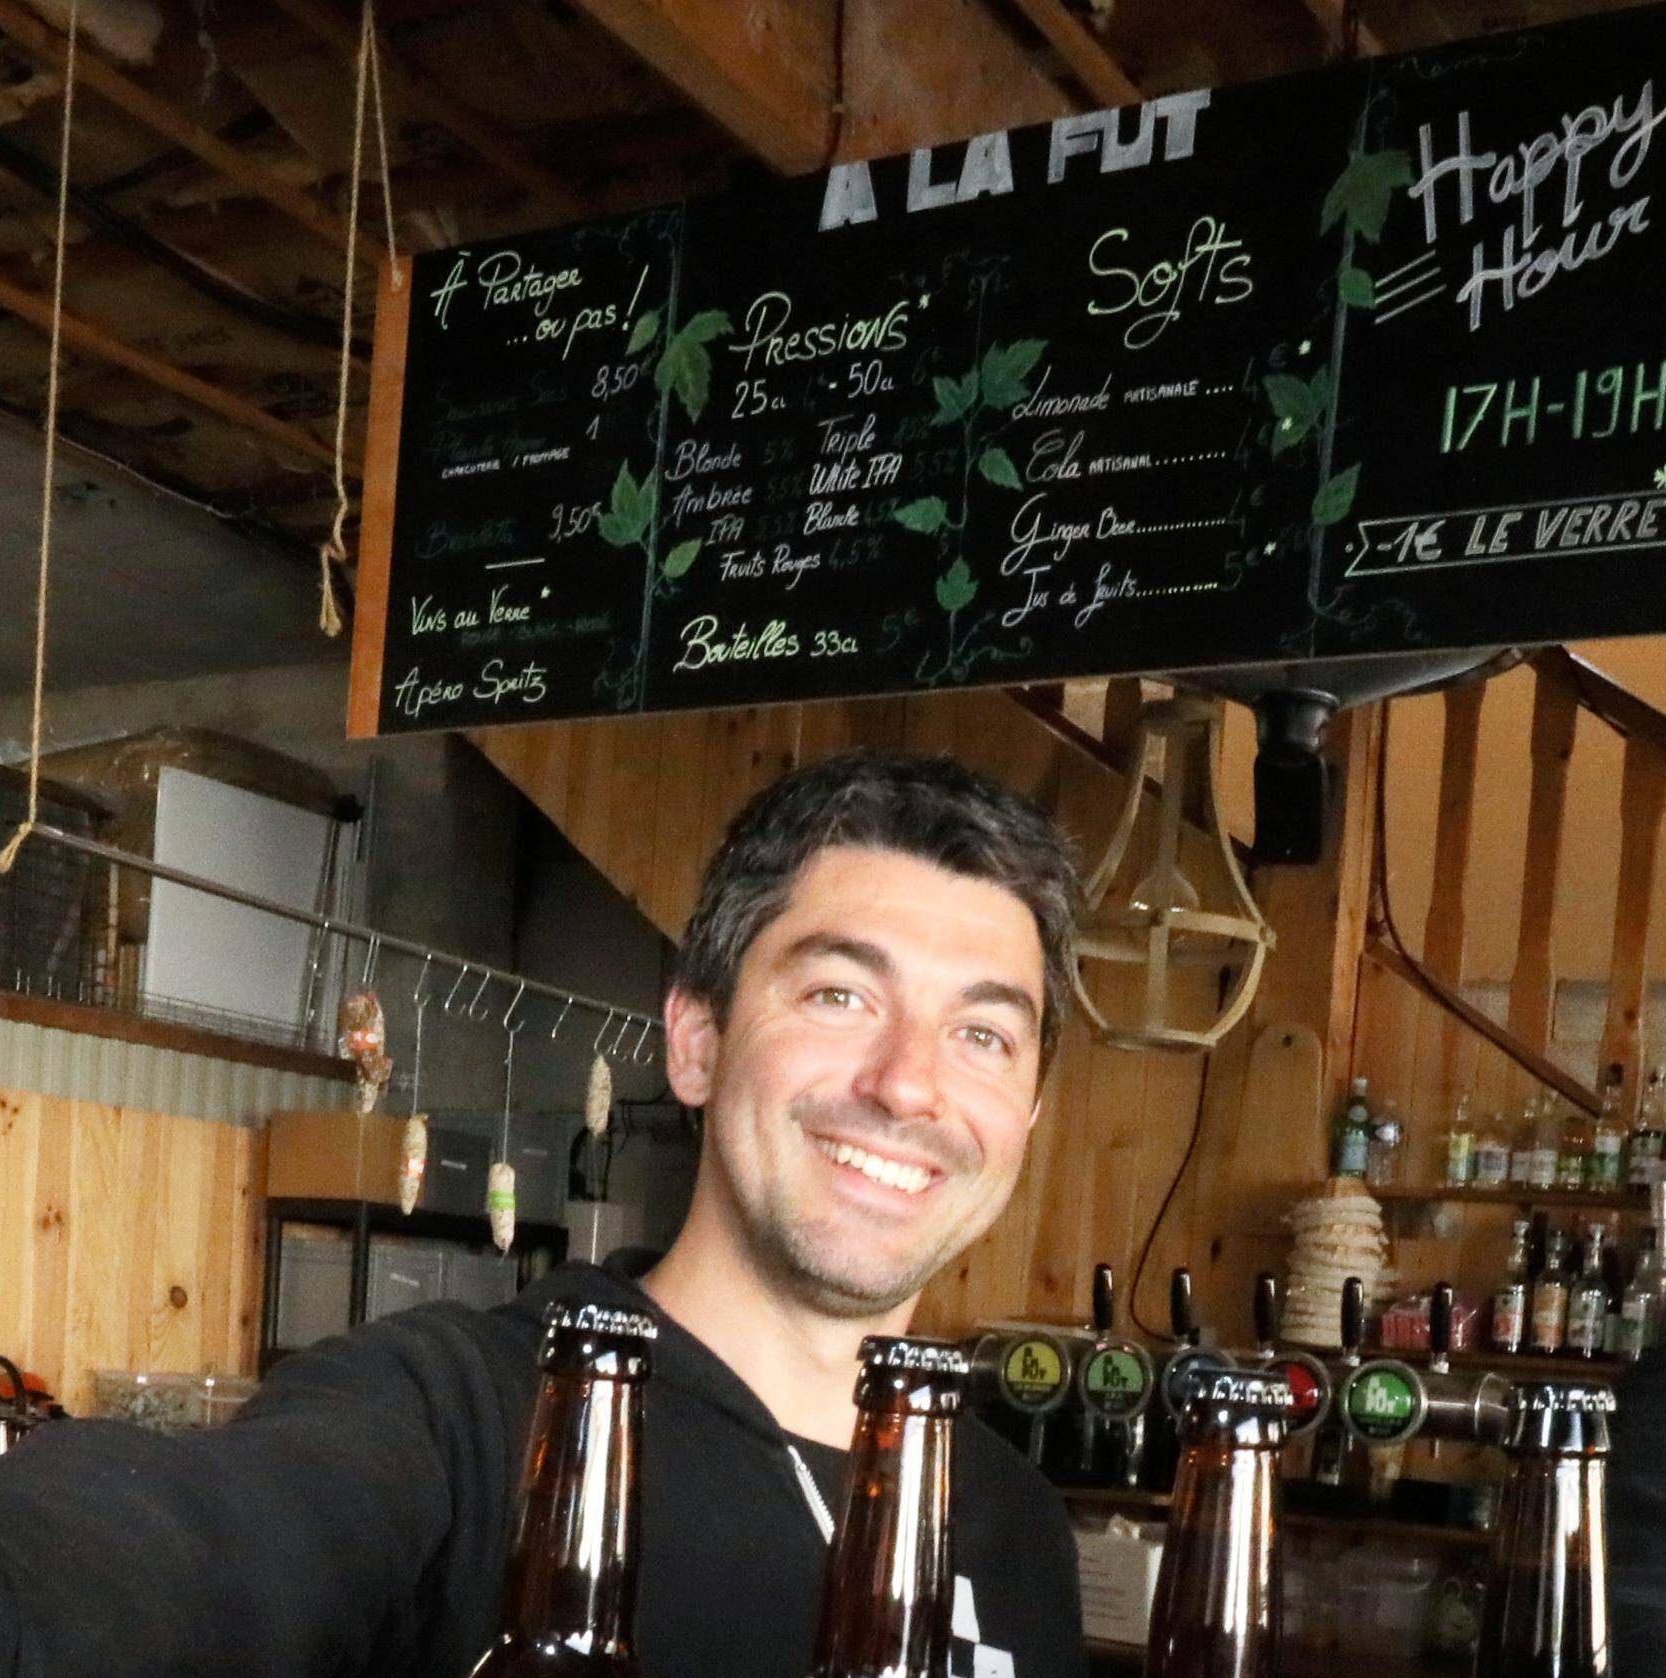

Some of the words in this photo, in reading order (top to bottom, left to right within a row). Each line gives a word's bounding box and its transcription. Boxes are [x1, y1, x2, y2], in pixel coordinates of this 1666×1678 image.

[478, 251, 584, 318] Partager
[1087, 215, 1253, 350] Softs
[1455, 195, 1652, 332] Hour
[1012, 365, 1113, 420] Limonade
[1124, 379, 1200, 404] ARTISANALE
[666, 438, 742, 481] Blonde
[815, 412, 876, 459] Triple
[1026, 429, 1085, 484] Cola
[863, 453, 903, 488] IPA
[671, 485, 754, 529] Ambrée
[1000, 492, 1090, 575] Ginger
[1464, 511, 1524, 556] LE
[771, 543, 821, 592] Rouges
[453, 610, 480, 631] au
[1001, 564, 1052, 629] Jus
[1059, 581, 1077, 606] de
[1074, 561, 1136, 631] fruits
[674, 613, 800, 673] Bouteilles
[473, 659, 547, 705] Spritz
